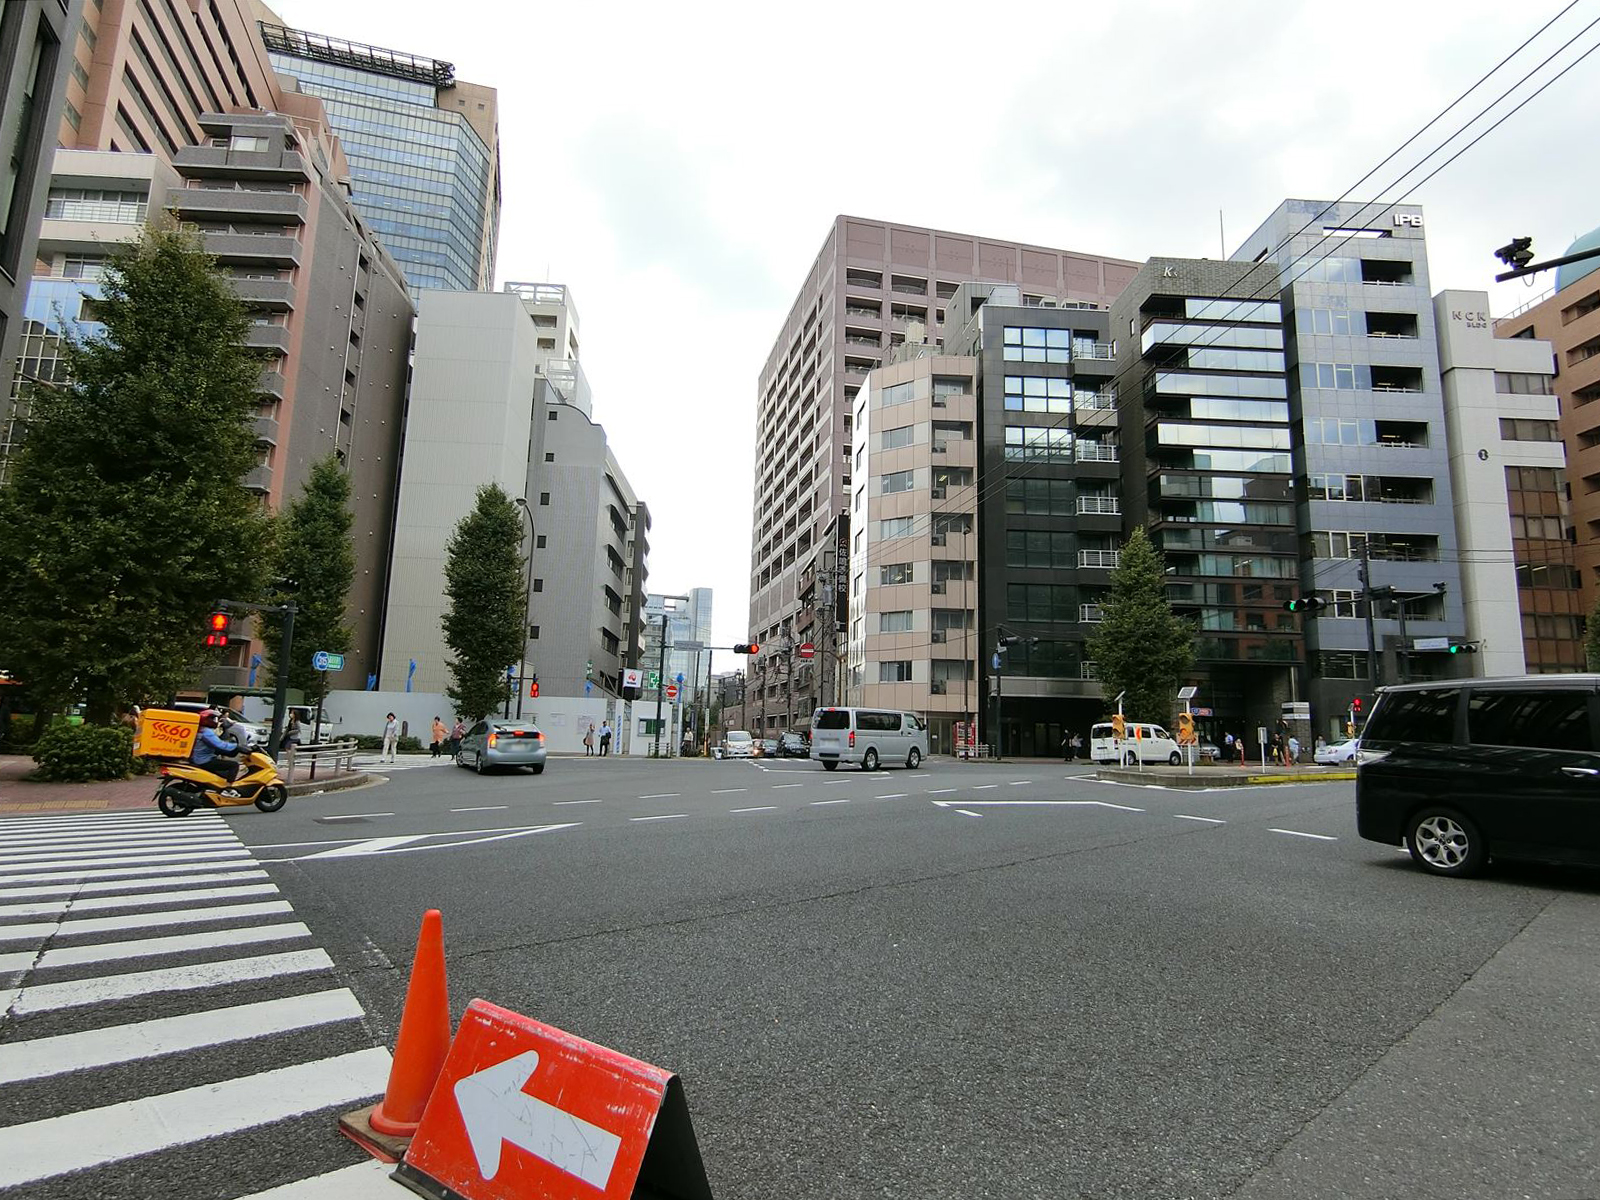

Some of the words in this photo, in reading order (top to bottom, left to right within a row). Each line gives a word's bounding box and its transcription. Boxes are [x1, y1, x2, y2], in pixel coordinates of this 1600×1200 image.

[1393, 213, 1424, 227] IPB
[1452, 310, 1487, 322] NCK
[151, 731, 180, 745] ソクハイ
[169, 724, 191, 738] 60
